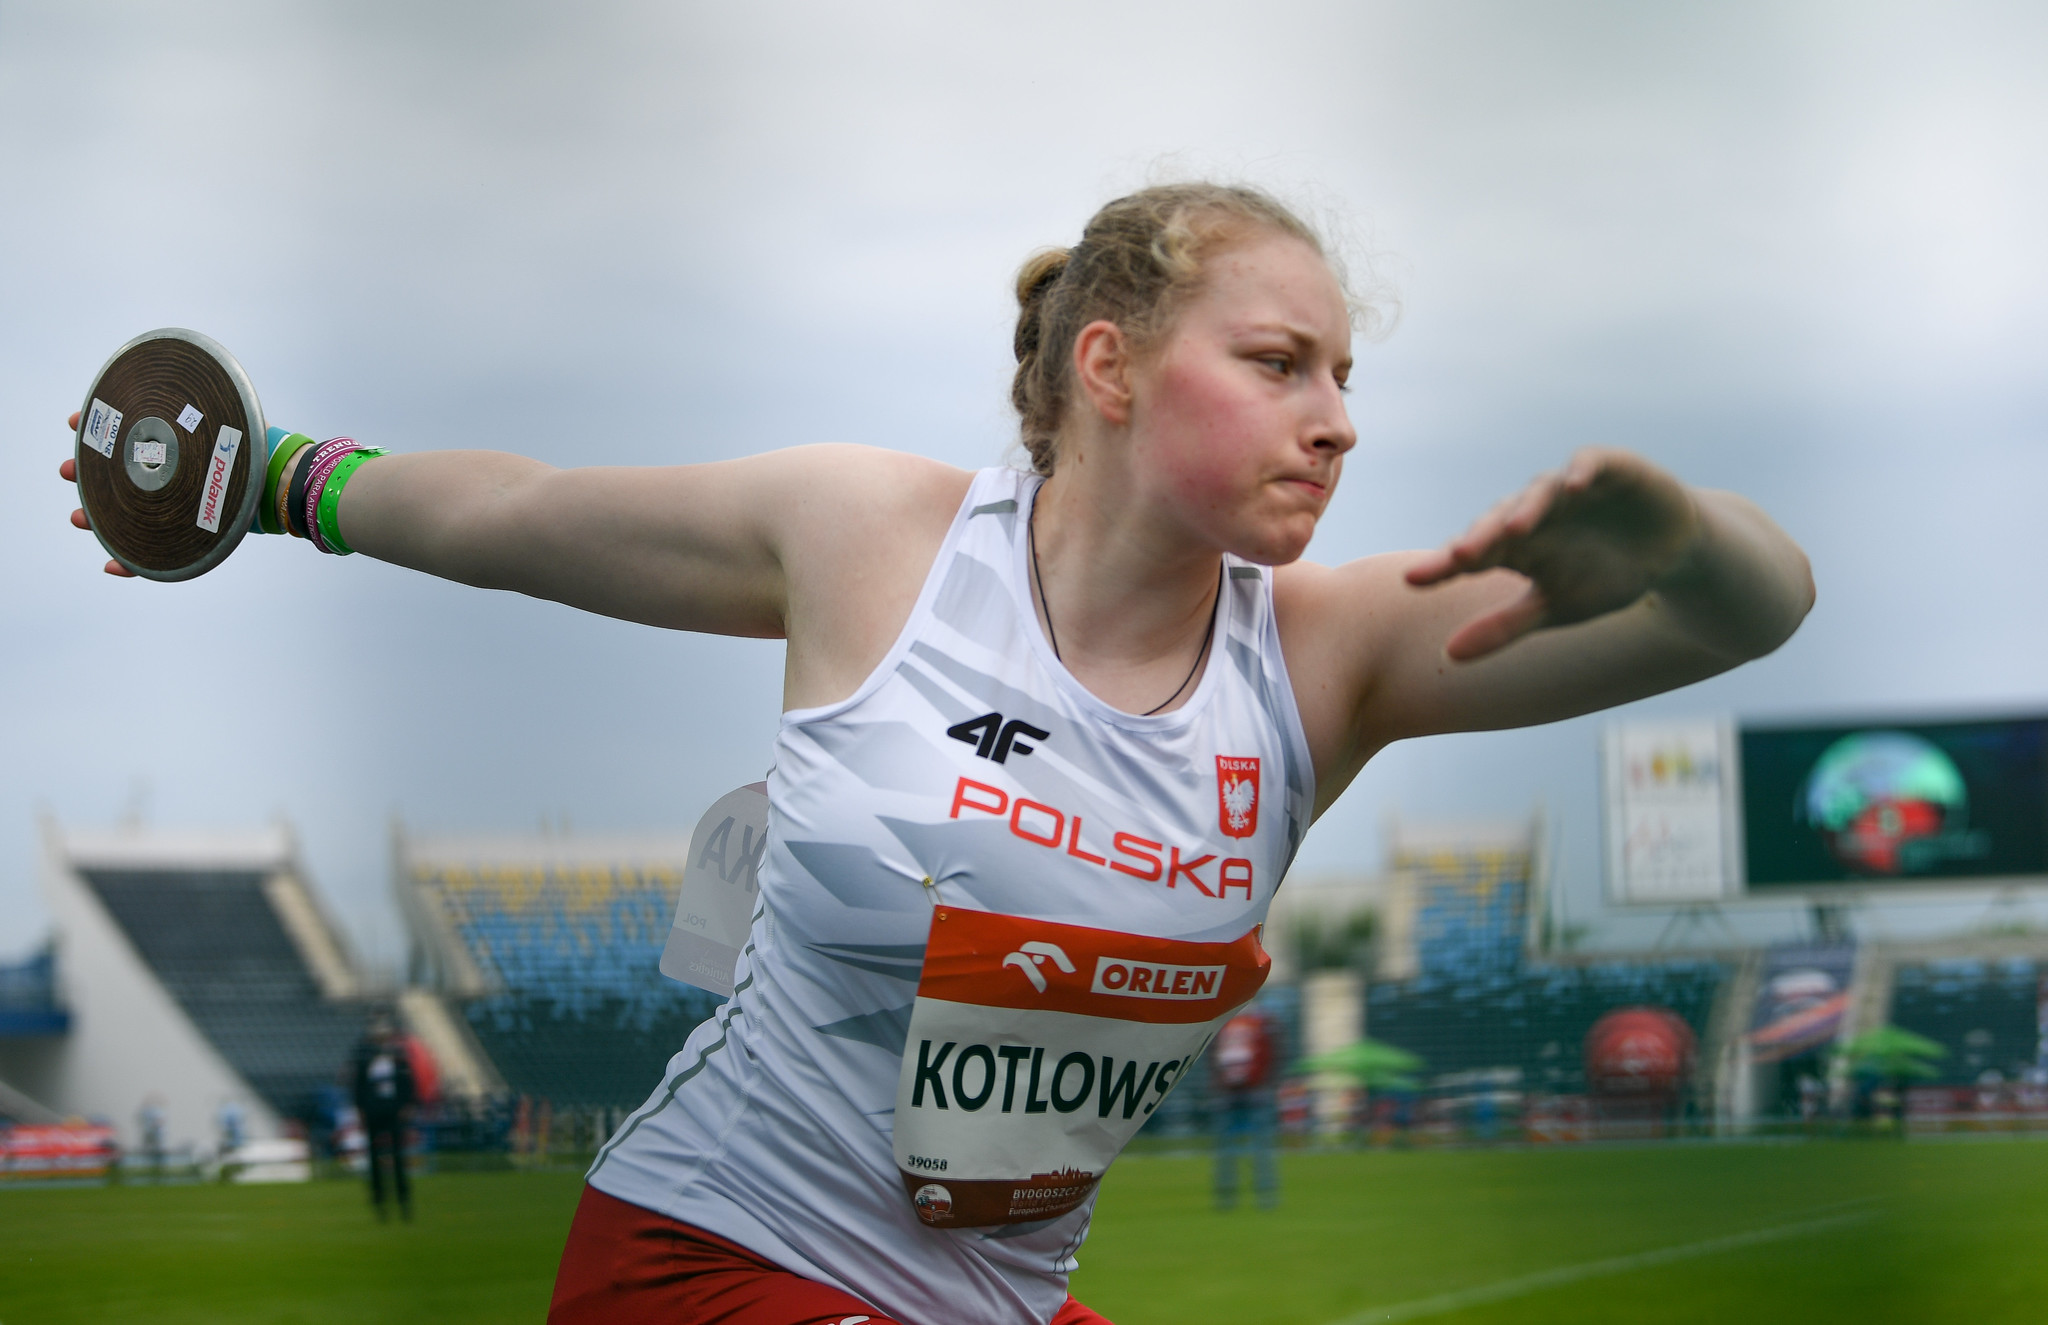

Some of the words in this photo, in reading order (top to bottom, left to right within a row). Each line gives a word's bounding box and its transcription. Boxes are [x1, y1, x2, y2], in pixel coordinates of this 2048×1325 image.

[110, 413, 121, 439] 1,00
[203, 456, 226, 524] polanik
[311, 475, 326, 496] PARA
[947, 712, 1050, 764] 4F
[950, 776, 1253, 900] POLSKA
[1101, 963, 1218, 995] ORLEN
[908, 1155, 948, 1171] 39058
[1013, 1187, 1079, 1200] BYDGOSZCZ
[1009, 1207, 1044, 1215] European
